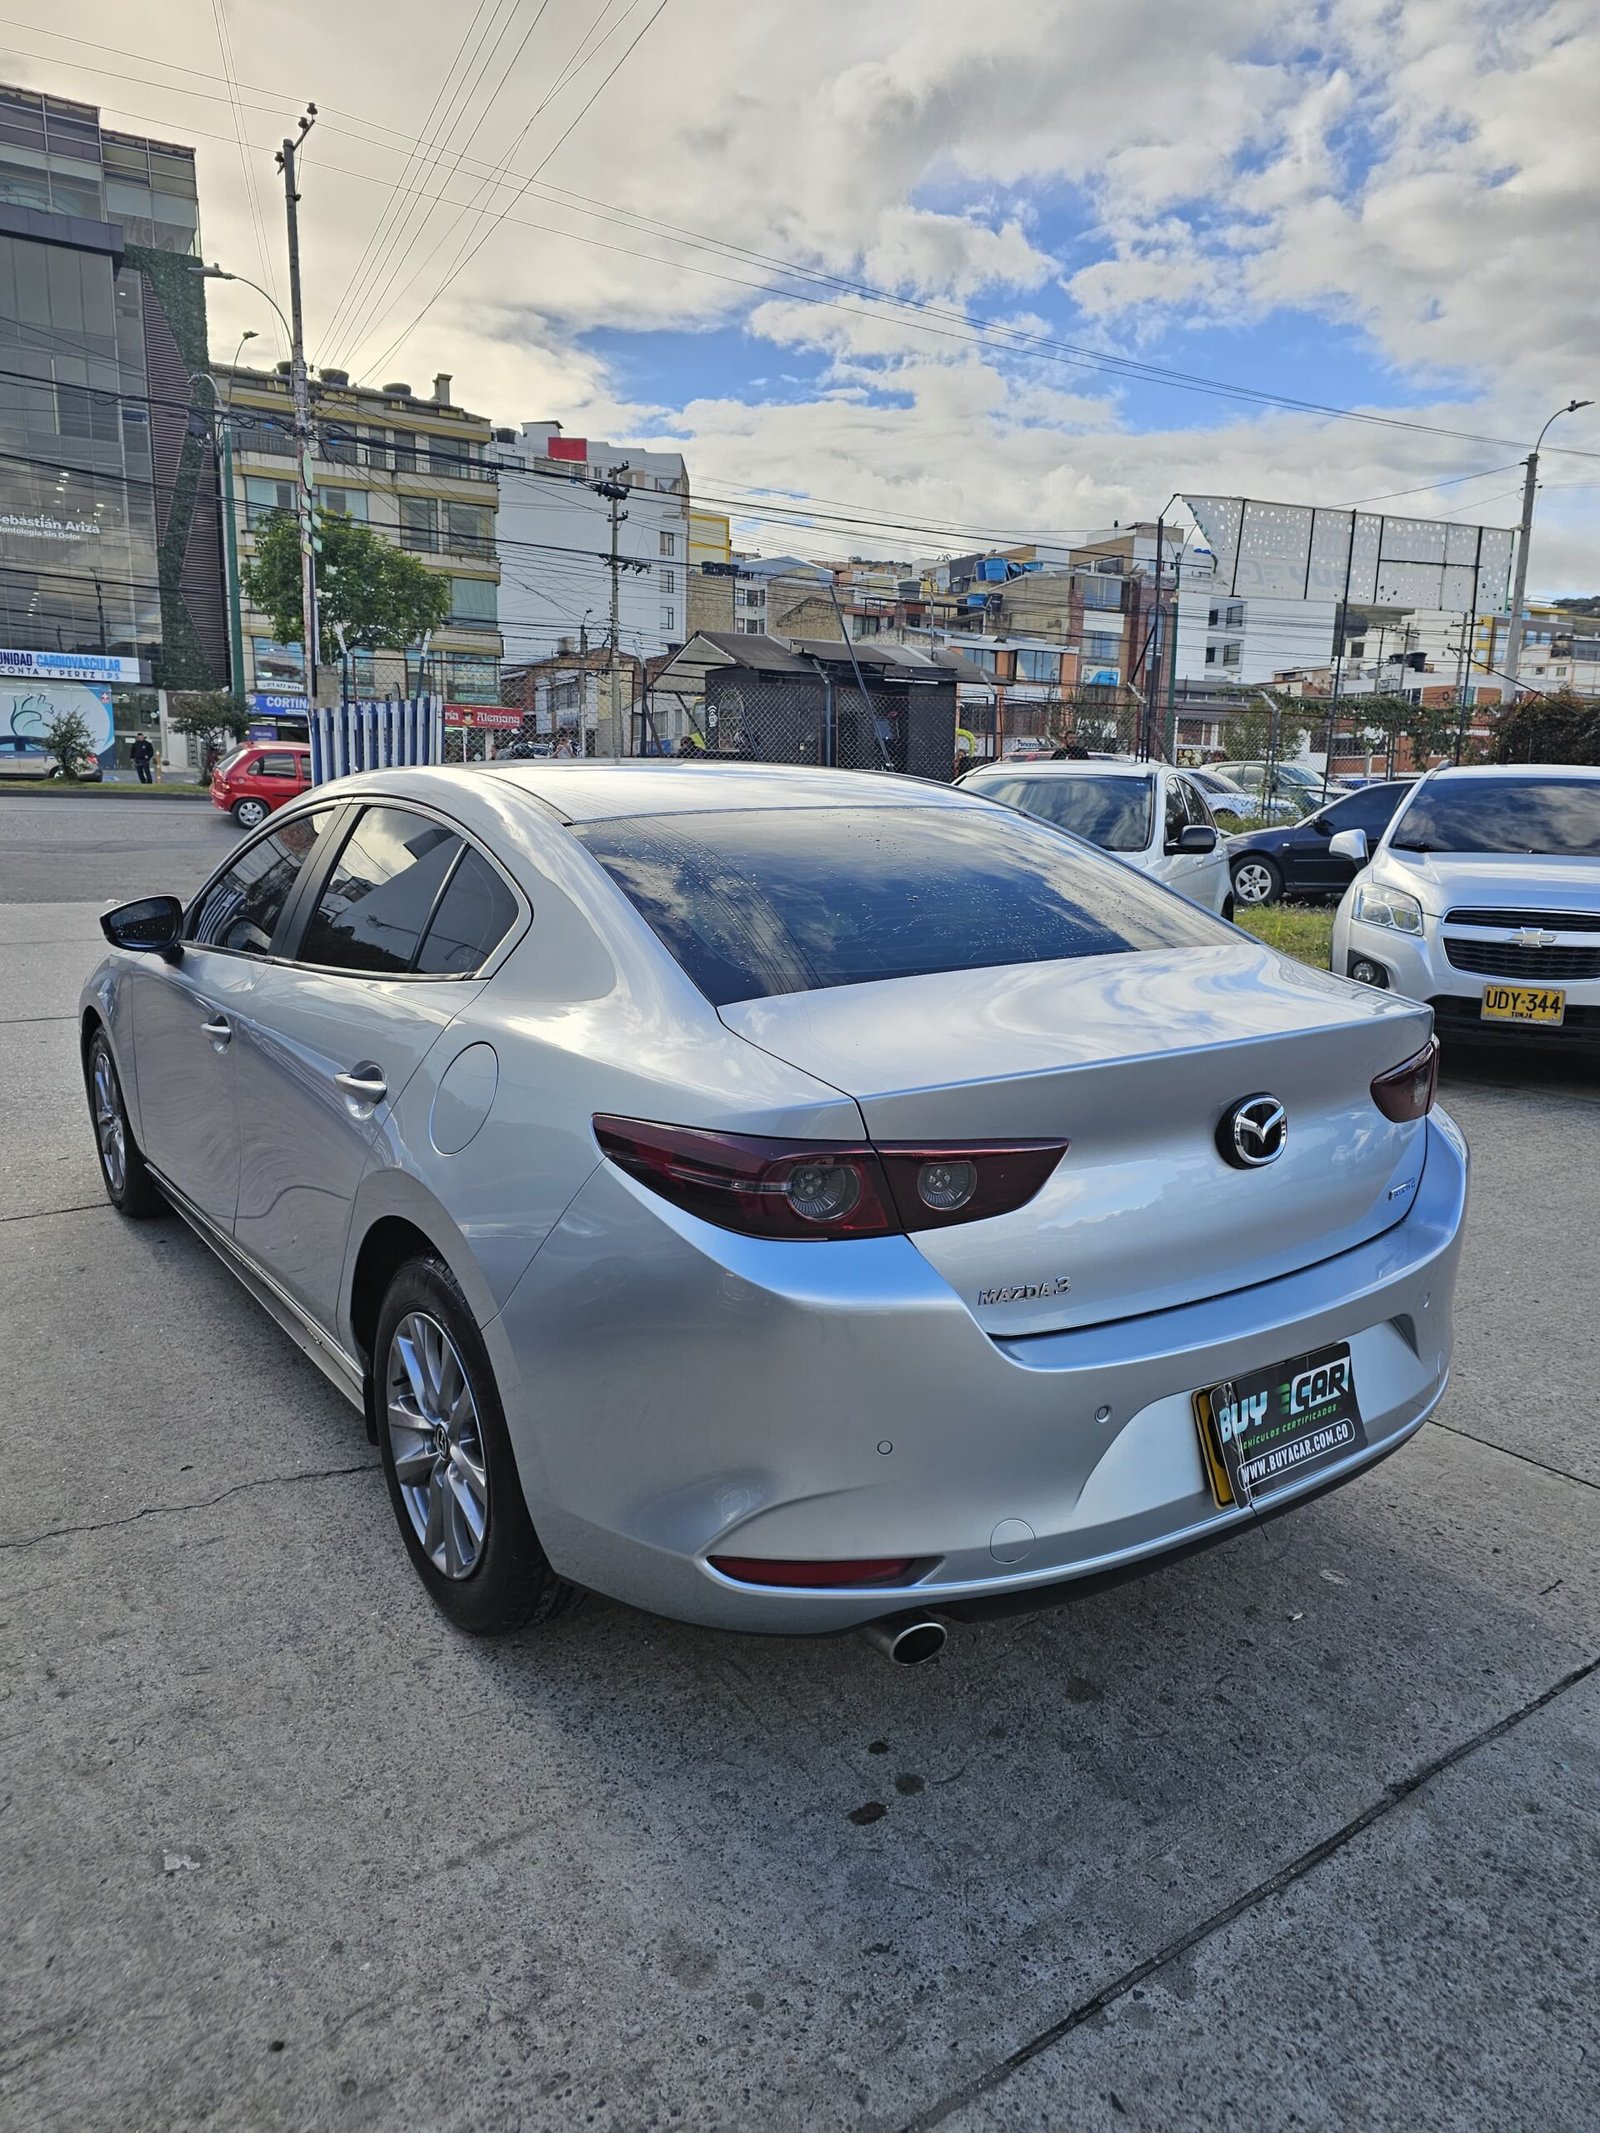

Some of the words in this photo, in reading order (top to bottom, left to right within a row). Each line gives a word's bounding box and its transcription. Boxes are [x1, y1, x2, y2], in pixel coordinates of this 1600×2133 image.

[0, 514, 62, 530] ebastián
[65, 521, 100, 534] Ariza
[59, 532, 80, 540] Dolor
[36, 654, 121, 672] CARDIOVASCULAR
[46, 668, 53, 676] Y
[59, 669, 96, 679] PEREZ
[101, 672, 121, 680] IPS
[266, 696, 309, 709] CORTIN
[1511, 1011, 1533, 1019] TUNJA
[1219, 1391, 1268, 1444] BUY
[1290, 1356, 1350, 1415] CAR
[1282, 1404, 1337, 1433] CERTIFICADOS
[1241, 1424, 1349, 1485] WWW.BUYACAR.COM.CO
